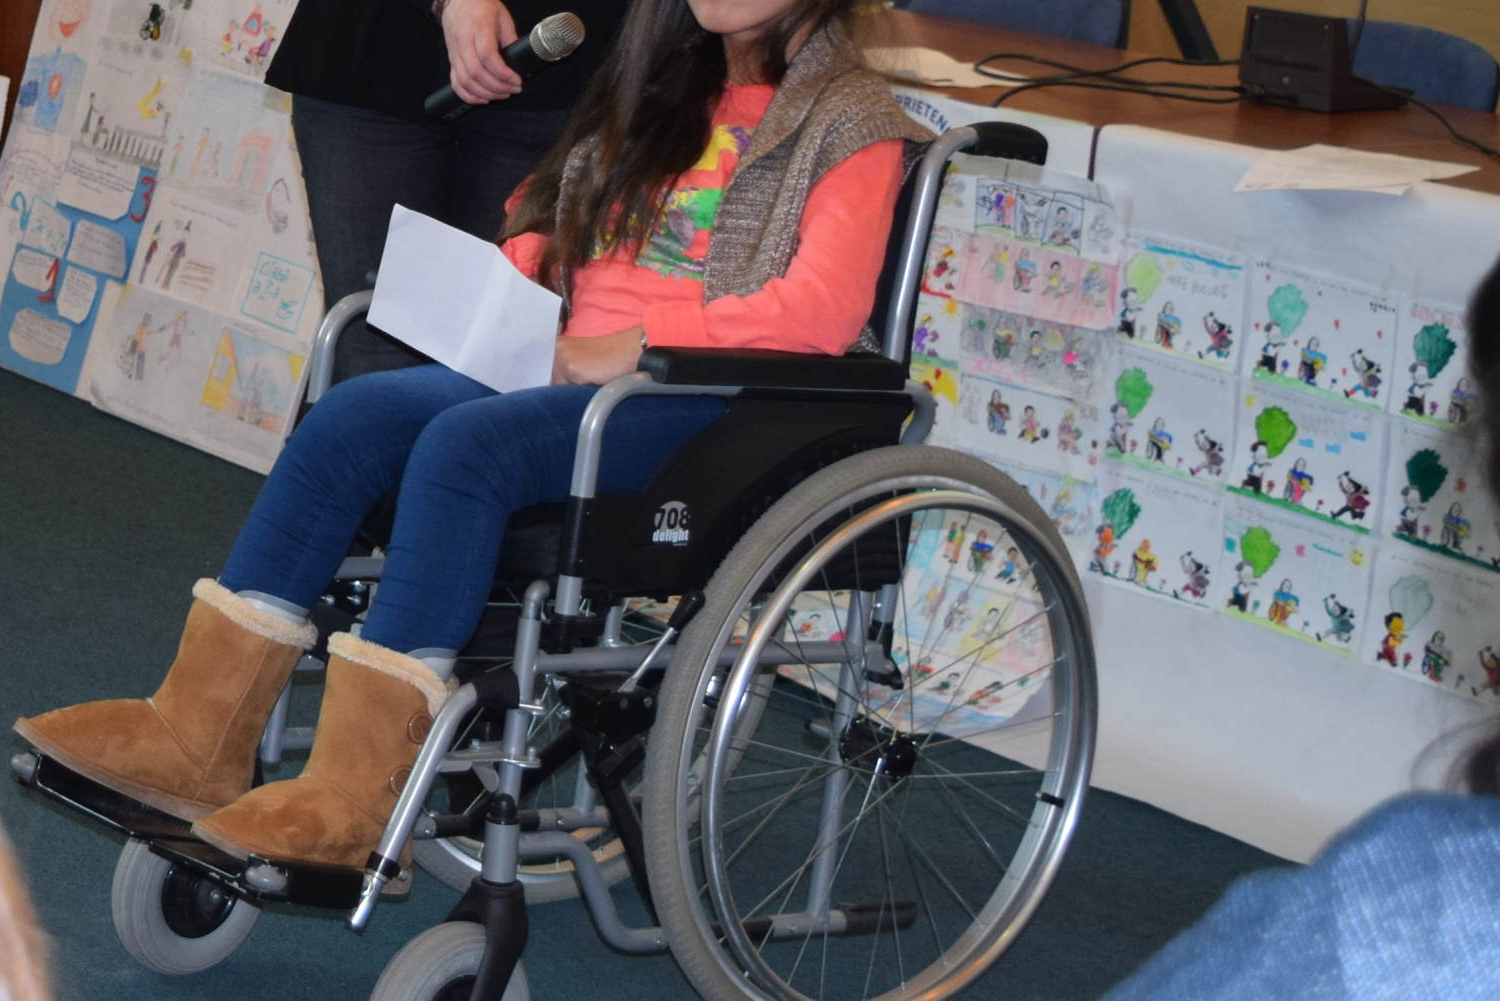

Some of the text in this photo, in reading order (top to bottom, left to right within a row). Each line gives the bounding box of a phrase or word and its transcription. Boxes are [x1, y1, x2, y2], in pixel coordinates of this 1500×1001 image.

[895, 94, 951, 133] PRIETEN
[129, 175, 157, 223] 3
[36, 258, 60, 303] 1
[652, 529, 689, 543] delight
[653, 506, 690, 530] 708
